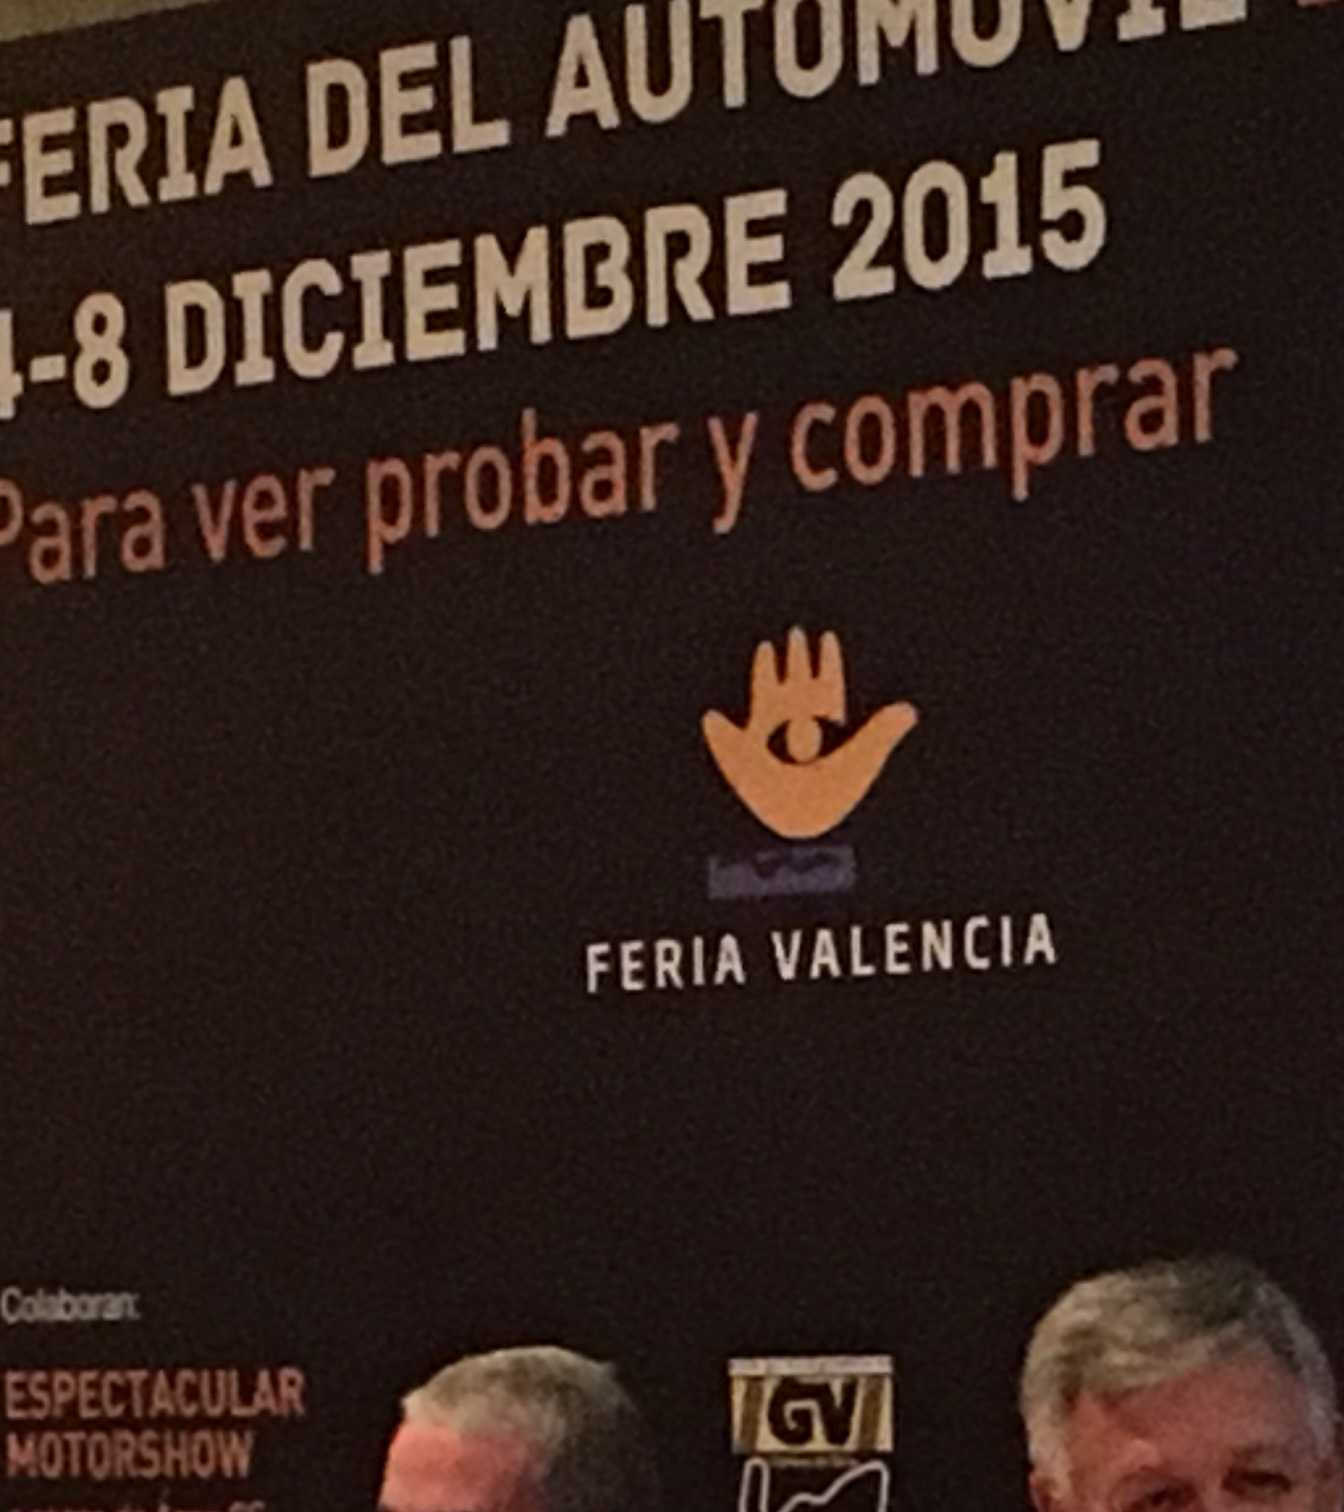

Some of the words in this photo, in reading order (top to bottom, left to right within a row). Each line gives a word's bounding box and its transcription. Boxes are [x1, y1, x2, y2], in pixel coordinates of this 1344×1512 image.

[305, 36, 511, 178] DEL
[545, 0, 1248, 138] AUTOMO
[164, 188, 792, 396] DICIEMBRE
[830, 138, 1107, 301] 2015
[193, 464, 336, 562] ver
[365, 407, 681, 575] probar
[707, 411, 759, 534] y
[790, 347, 1238, 502] comprar
[586, 933, 746, 994] FERIA
[770, 912, 1057, 981] VALENCIA
[3, 1366, 305, 1421] ESPECTACULAR
[6, 1428, 254, 1480] MOTORSHOW
